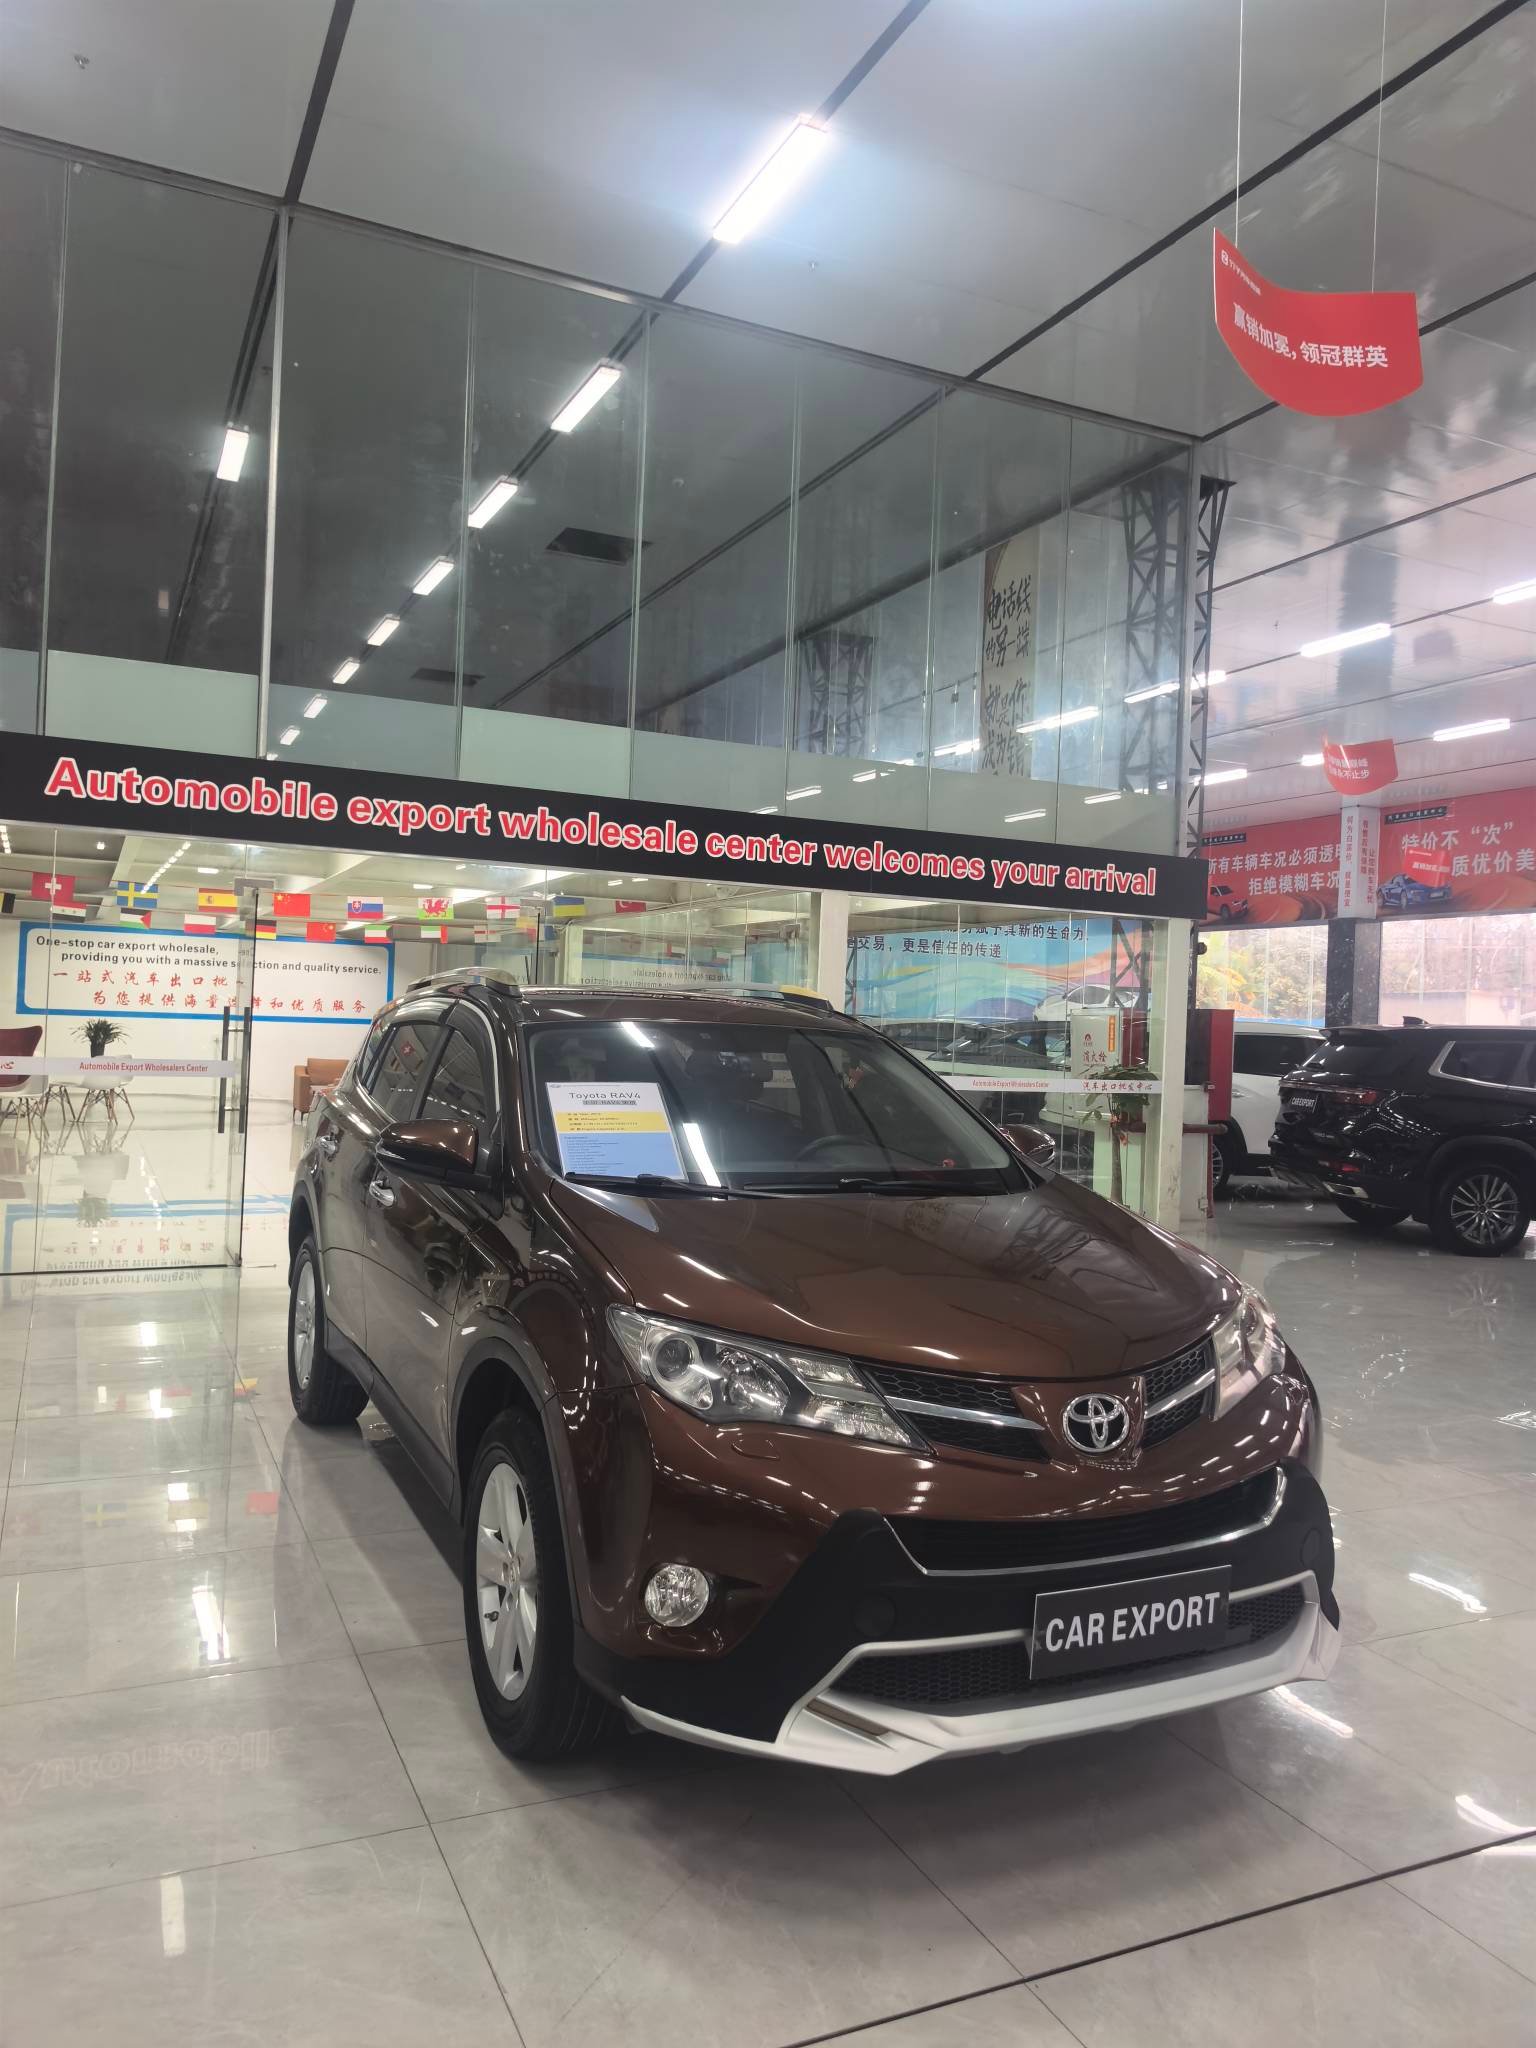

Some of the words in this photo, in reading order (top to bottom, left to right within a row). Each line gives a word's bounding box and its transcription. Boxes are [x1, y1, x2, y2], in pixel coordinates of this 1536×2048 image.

[45, 757, 338, 821] Automobile
[347, 795, 491, 837] export
[499, 807, 698, 856] wholesale
[704, 832, 817, 866] center
[824, 840, 986, 881] welcomes
[991, 858, 1060, 889] your
[1065, 863, 1157, 897] arrival
[1451, 847, 1536, 878] 质优价美
[36, 935, 95, 949] One-stop
[97, 940, 116, 949] car
[118, 941, 156, 952] export
[159, 942, 219, 955] wholesale,
[61, 951, 119, 965] providing
[121, 955, 143, 965] you
[145, 955, 171, 965] with
[183, 958, 228, 967] massive
[282, 962, 301, 971] and
[303, 963, 341, 974] quality
[342, 965, 382, 974] service.
[52, 969, 244, 988] 一站式汽车出口批
[79, 1062, 119, 1071] Automobile
[121, 1063, 143, 1072] Export
[144, 1064, 185, 1072] Wholesalers
[186, 1064, 208, 1072] Center
[1045, 1612, 1105, 1652] CAR
[1112, 1591, 1221, 1642] EXPORT
